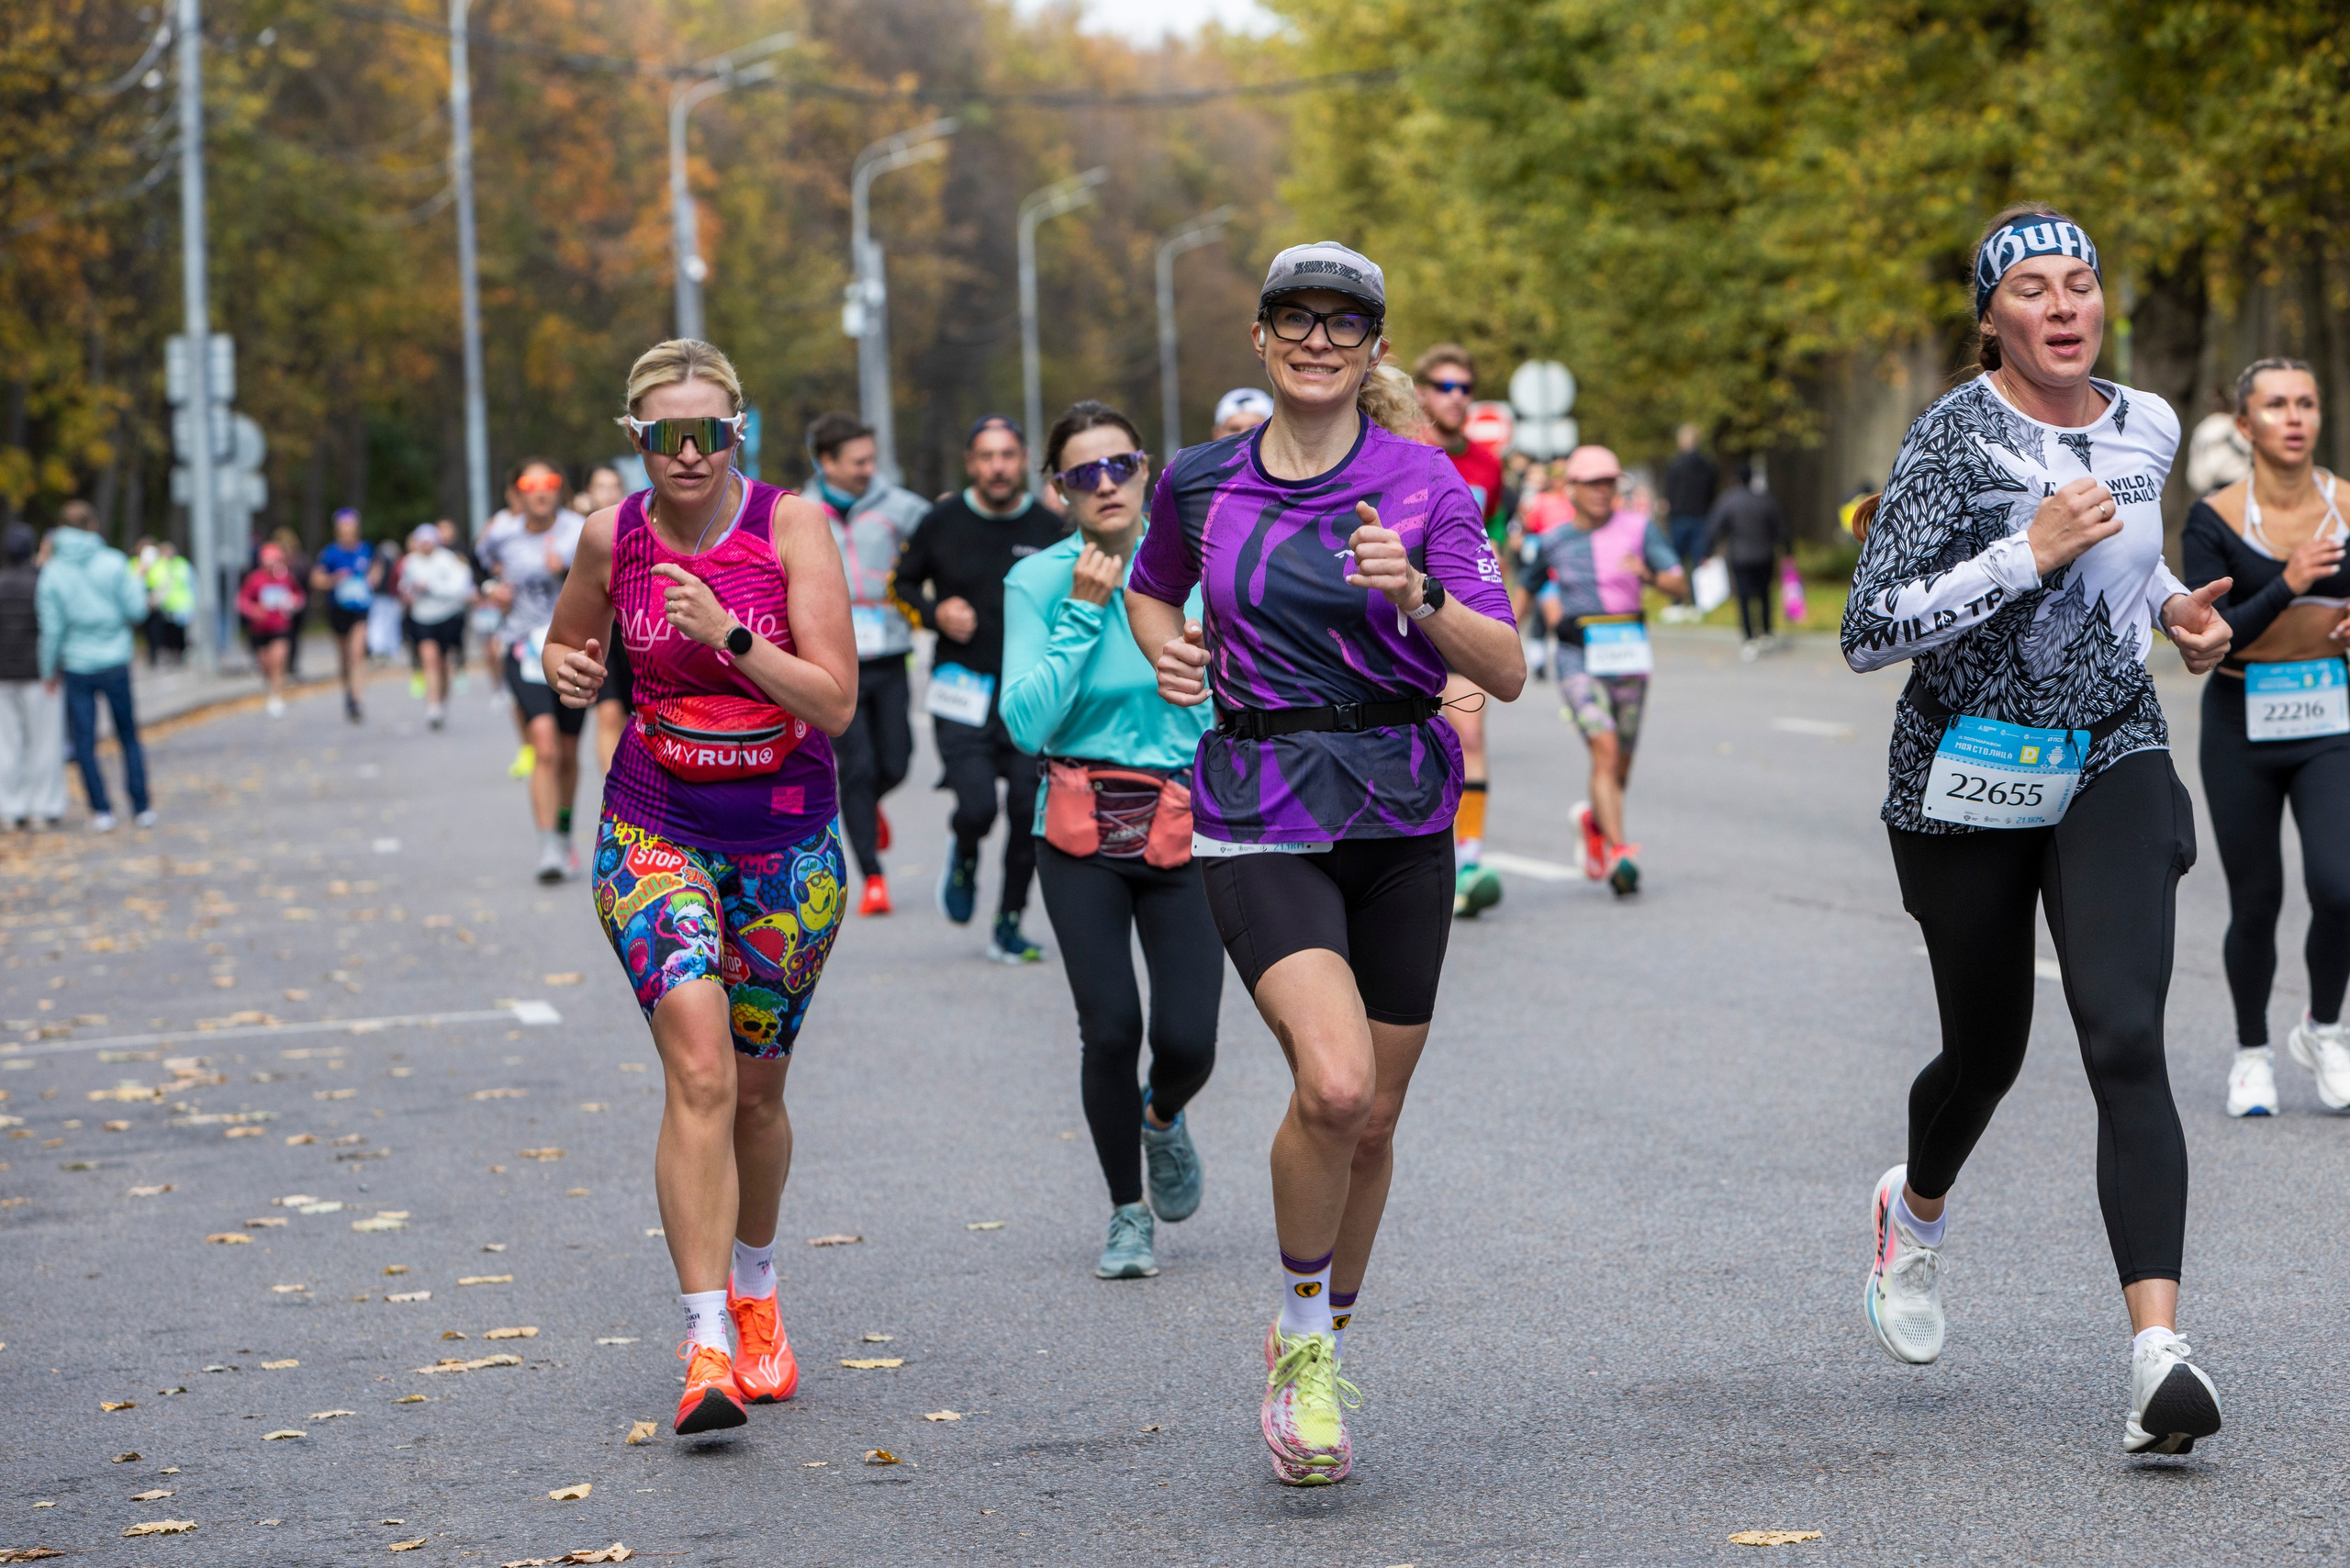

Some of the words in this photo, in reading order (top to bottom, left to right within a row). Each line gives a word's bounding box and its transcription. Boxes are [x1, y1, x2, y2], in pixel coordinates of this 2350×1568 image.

[1983, 222, 2092, 281] Buff
[2105, 475, 2146, 492] WILD
[2111, 488, 2154, 506] TRAIL
[2263, 700, 2297, 722] 22216
[1972, 745, 2013, 759] СТОЛИЦА
[1946, 773, 2044, 806] 22655
[634, 848, 682, 868] STOP
